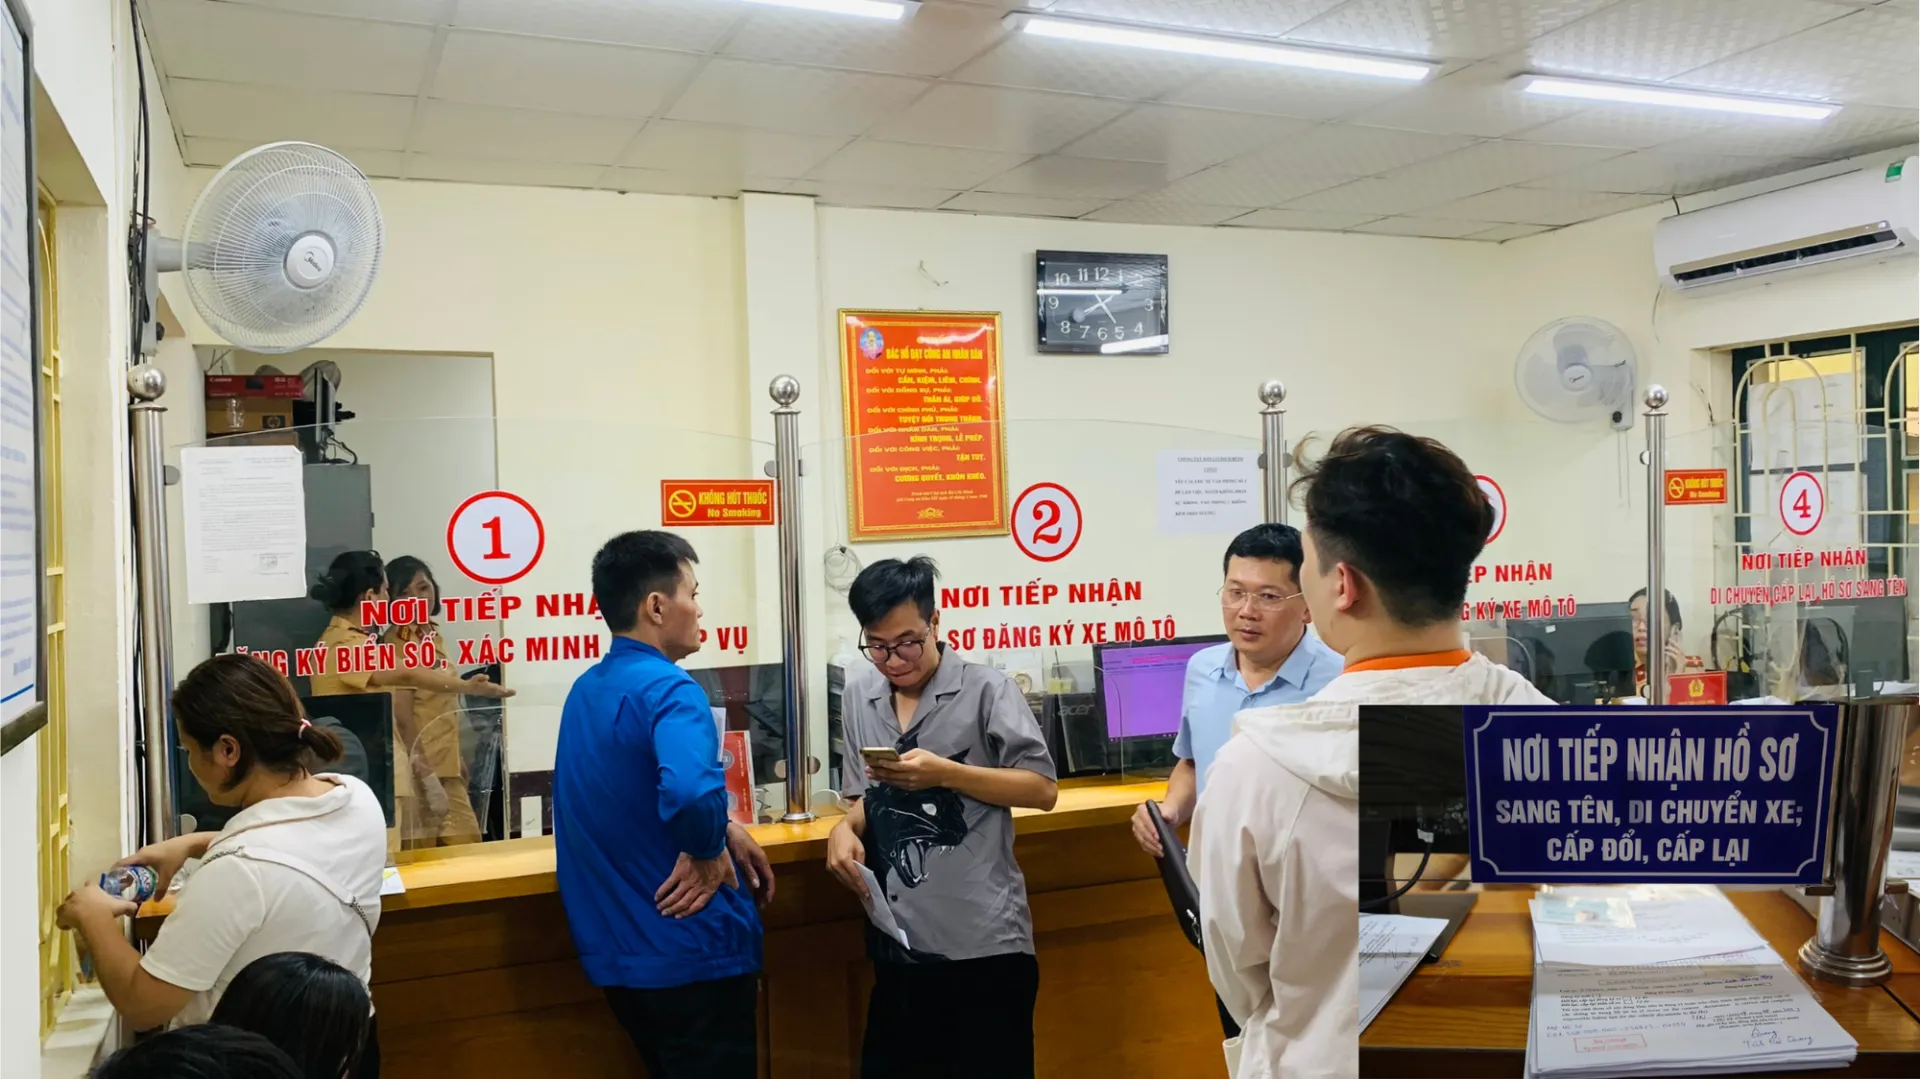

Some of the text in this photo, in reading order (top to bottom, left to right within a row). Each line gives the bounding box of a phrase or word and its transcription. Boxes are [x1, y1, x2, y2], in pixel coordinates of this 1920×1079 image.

[1054, 273, 1070, 286] 10
[1078, 268, 1088, 281] 11
[1094, 267, 1109, 281] 12
[1118, 269, 1124, 282] 1
[1048, 296, 1059, 309] 9
[1144, 298, 1154, 311] 3
[1060, 321, 1070, 333] 8
[1079, 325, 1091, 339] 7
[1097, 327, 1108, 340] 6
[1114, 326, 1124, 340] 5
[1134, 322, 1144, 335] 4
[699, 487, 768, 505] KHÔNG HÚT THUỐC
[1793, 489, 1811, 519] 4
[707, 508, 762, 518] No Smoking
[1033, 499, 1062, 544] 2
[481, 516, 511, 560] 1
[1742, 545, 1866, 570] NƠI TIẾP NHẬN
[1495, 560, 1553, 586] NHẬN
[941, 578, 1142, 609] NƠI TIẾP NHẬN
[1711, 587, 1722, 605] DI
[1839, 581, 1853, 598] SƠ
[1856, 579, 1884, 597] SANG
[361, 588, 603, 626] NƠI TIẾP NH
[1476, 597, 1496, 620] KÝ
[1502, 600, 1521, 619] XE
[1528, 595, 1551, 617] MÔ
[1557, 594, 1576, 616] TÔ
[947, 614, 1176, 651] SƠ ĐĂNG KÝ XE MÔ TÔ
[296, 642, 327, 676] KÝ
[336, 634, 395, 672] BIỂN
[458, 633, 515, 665] XÁC
[526, 634, 600, 662] MINH
[716, 625, 748, 655] VỤ
[1058, 703, 1095, 716] acer
[1502, 721, 1799, 791] NƠI TIẾP NHẬN HỒ SƠ
[1496, 789, 1803, 827] SANG TÊN, DI CHUYỂN XE;
[1547, 829, 1749, 867] CẤP ĐỔI, CẤP LẠI
